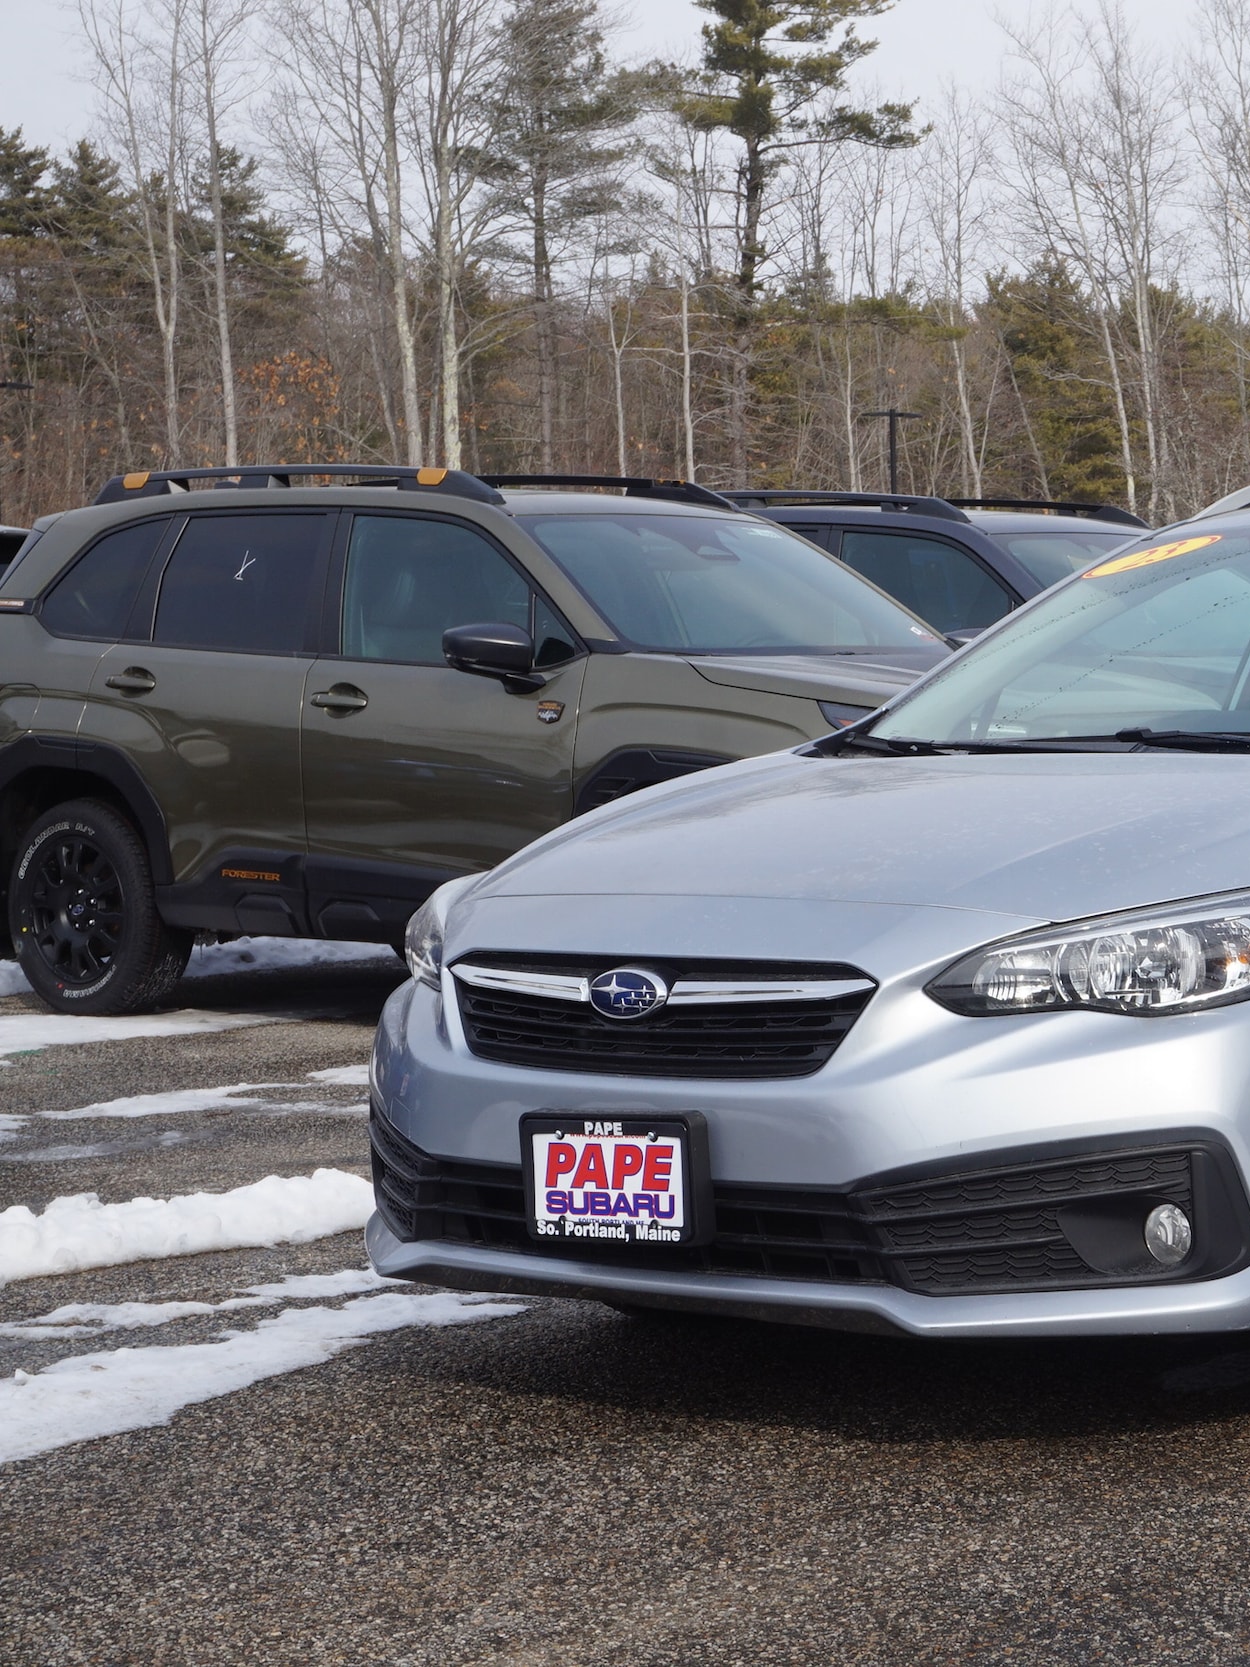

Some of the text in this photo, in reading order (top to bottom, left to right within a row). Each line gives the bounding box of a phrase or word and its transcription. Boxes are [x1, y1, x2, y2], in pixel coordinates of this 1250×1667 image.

[221, 869, 280, 881] FORESTER
[584, 1121, 623, 1136] PAPE
[545, 1142, 674, 1192] PAPE
[546, 1190, 675, 1220] SUBARU
[537, 1220, 680, 1242] So. Portland, Maine
